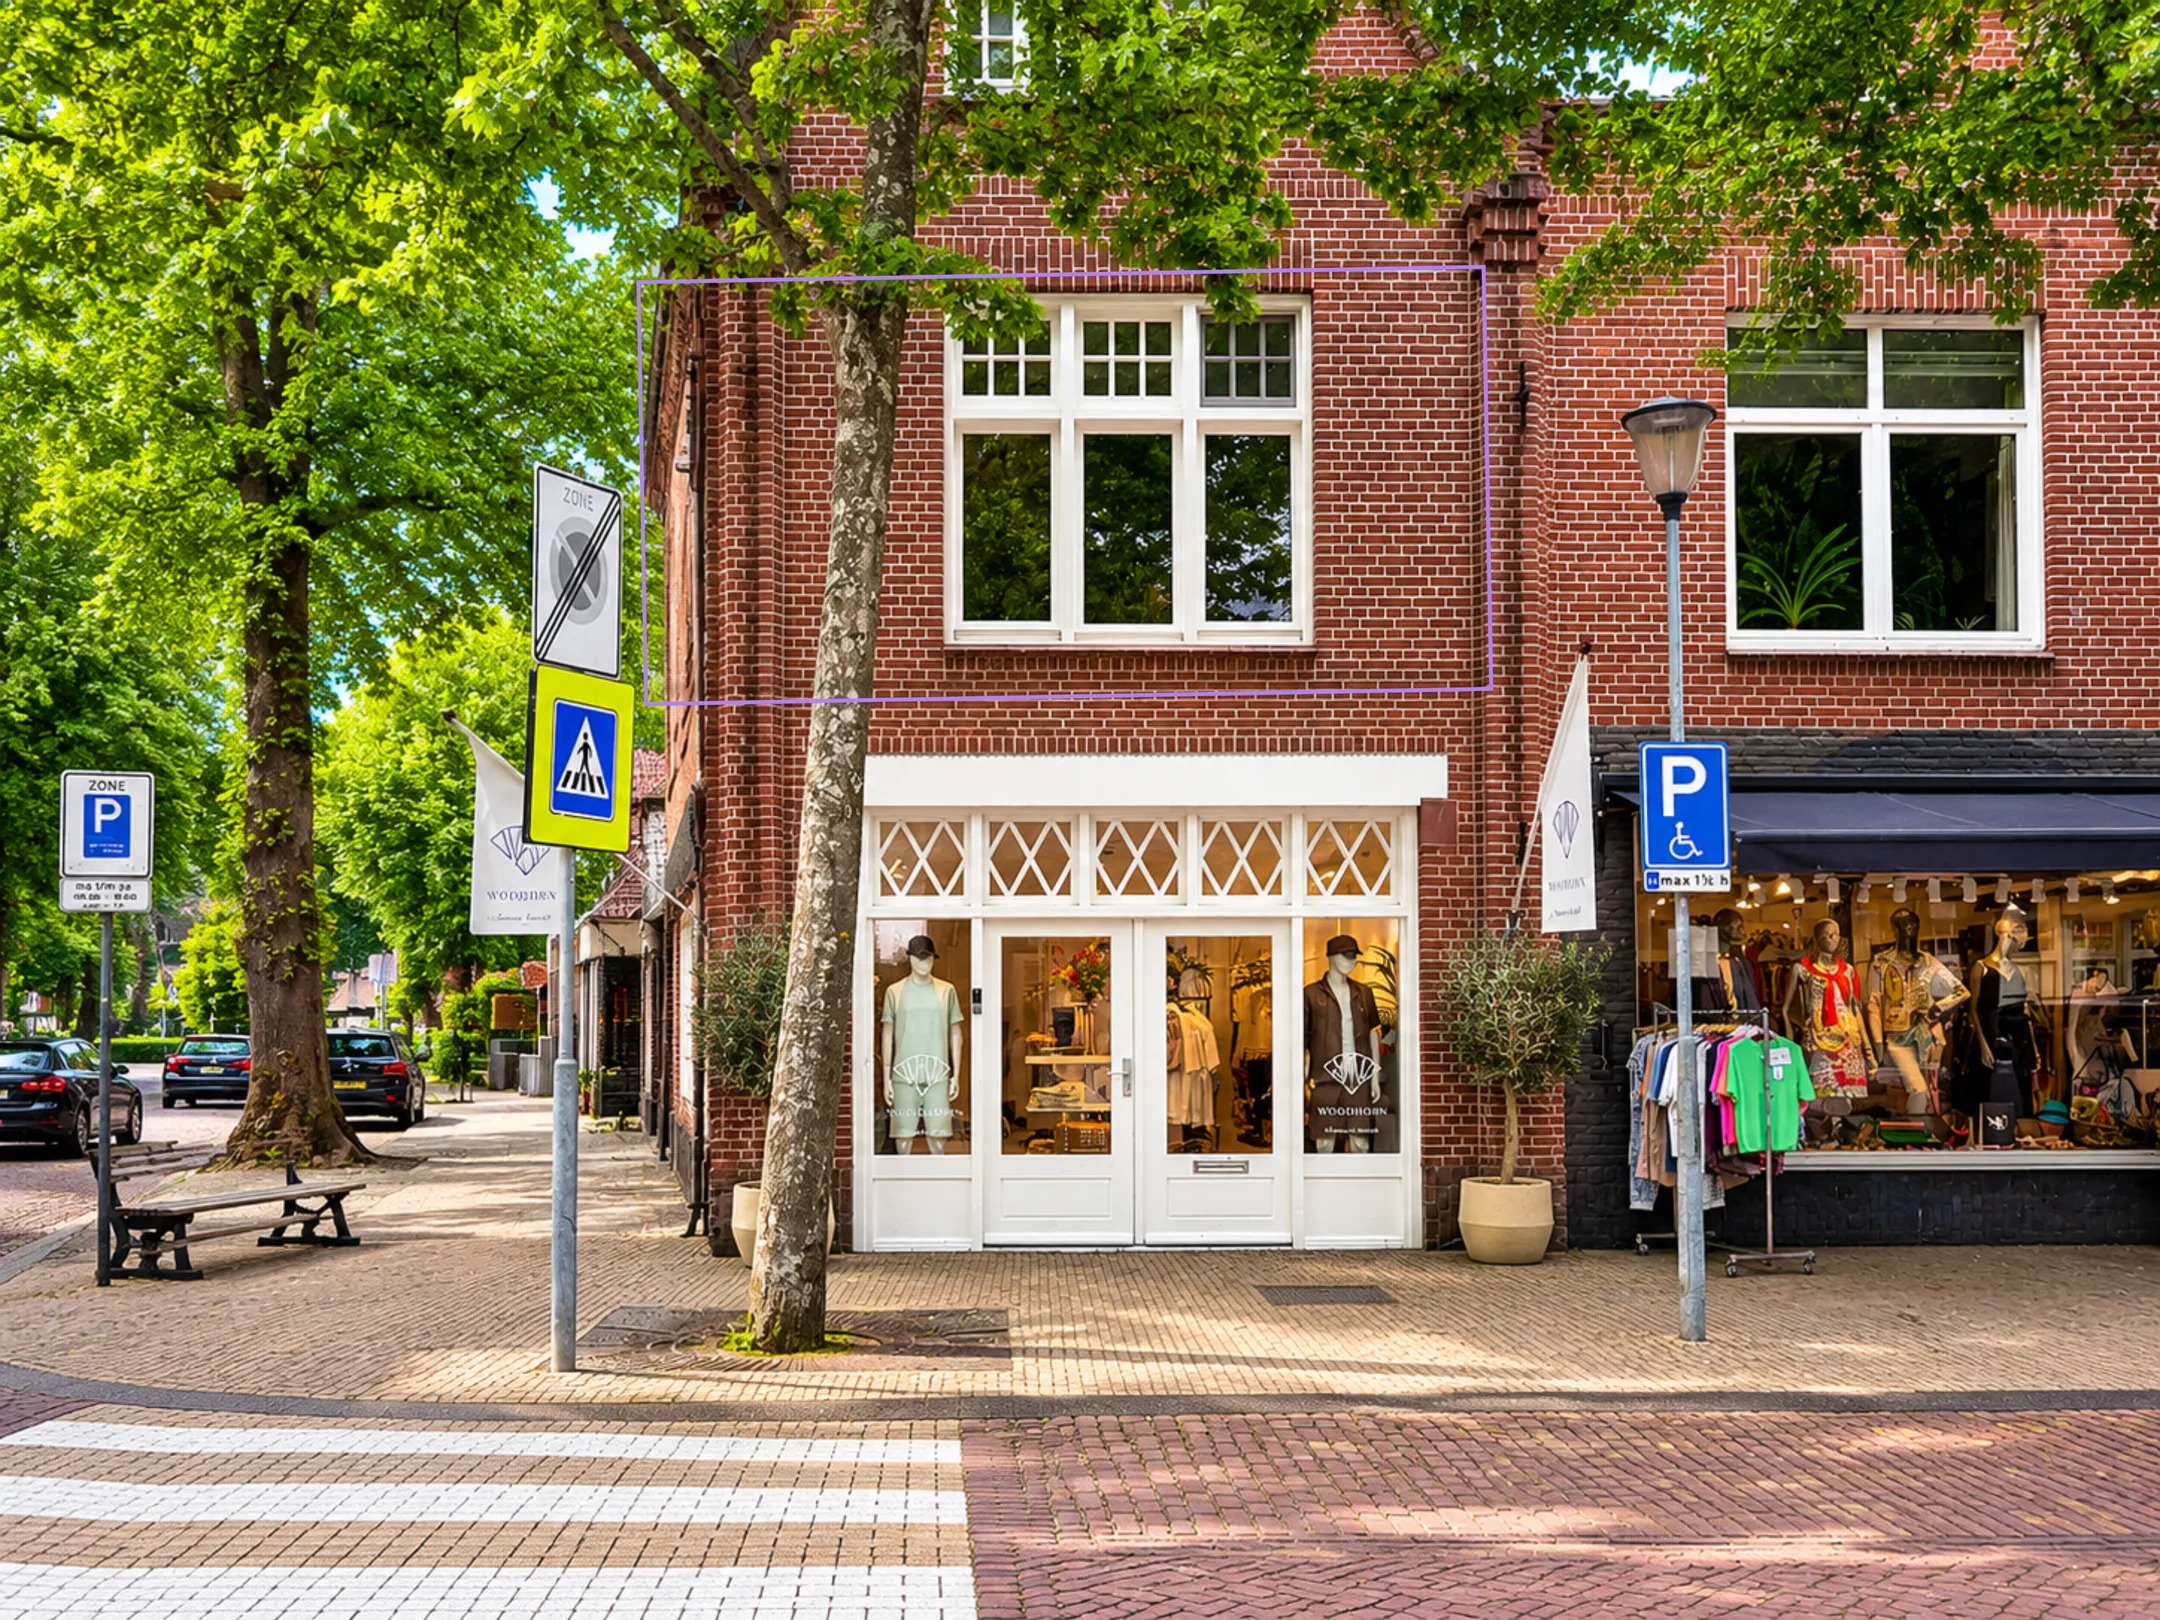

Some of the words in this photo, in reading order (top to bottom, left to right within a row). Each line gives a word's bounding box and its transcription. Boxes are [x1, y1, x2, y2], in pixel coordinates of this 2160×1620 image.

[563, 487, 594, 512] ZONE
[88, 780, 126, 792] ZONE
[1662, 755, 1707, 817] P
[94, 797, 122, 833] P
[1660, 876, 1691, 886] max
[1316, 1106, 1388, 1116] WOODHORN
